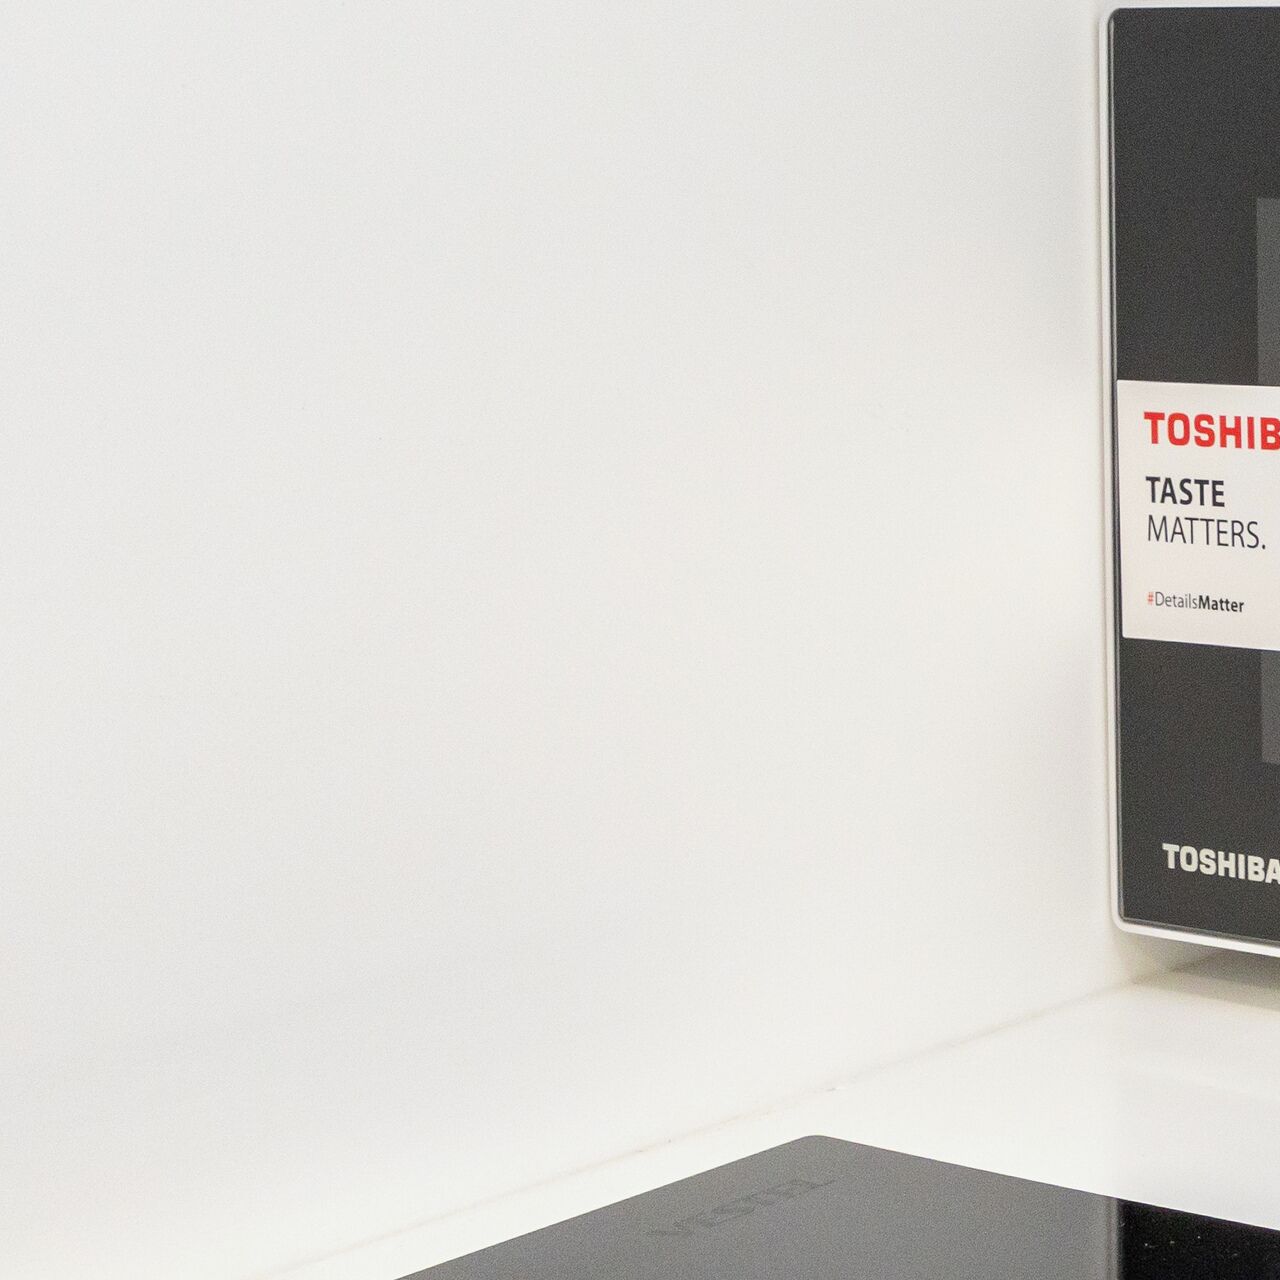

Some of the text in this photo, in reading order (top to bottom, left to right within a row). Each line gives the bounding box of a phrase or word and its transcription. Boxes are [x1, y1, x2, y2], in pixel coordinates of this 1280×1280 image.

[1146, 476, 1225, 507] TASTE
[1147, 514, 1266, 549] MATTERS.
[1147, 591, 1244, 612] #DetailsMatter
